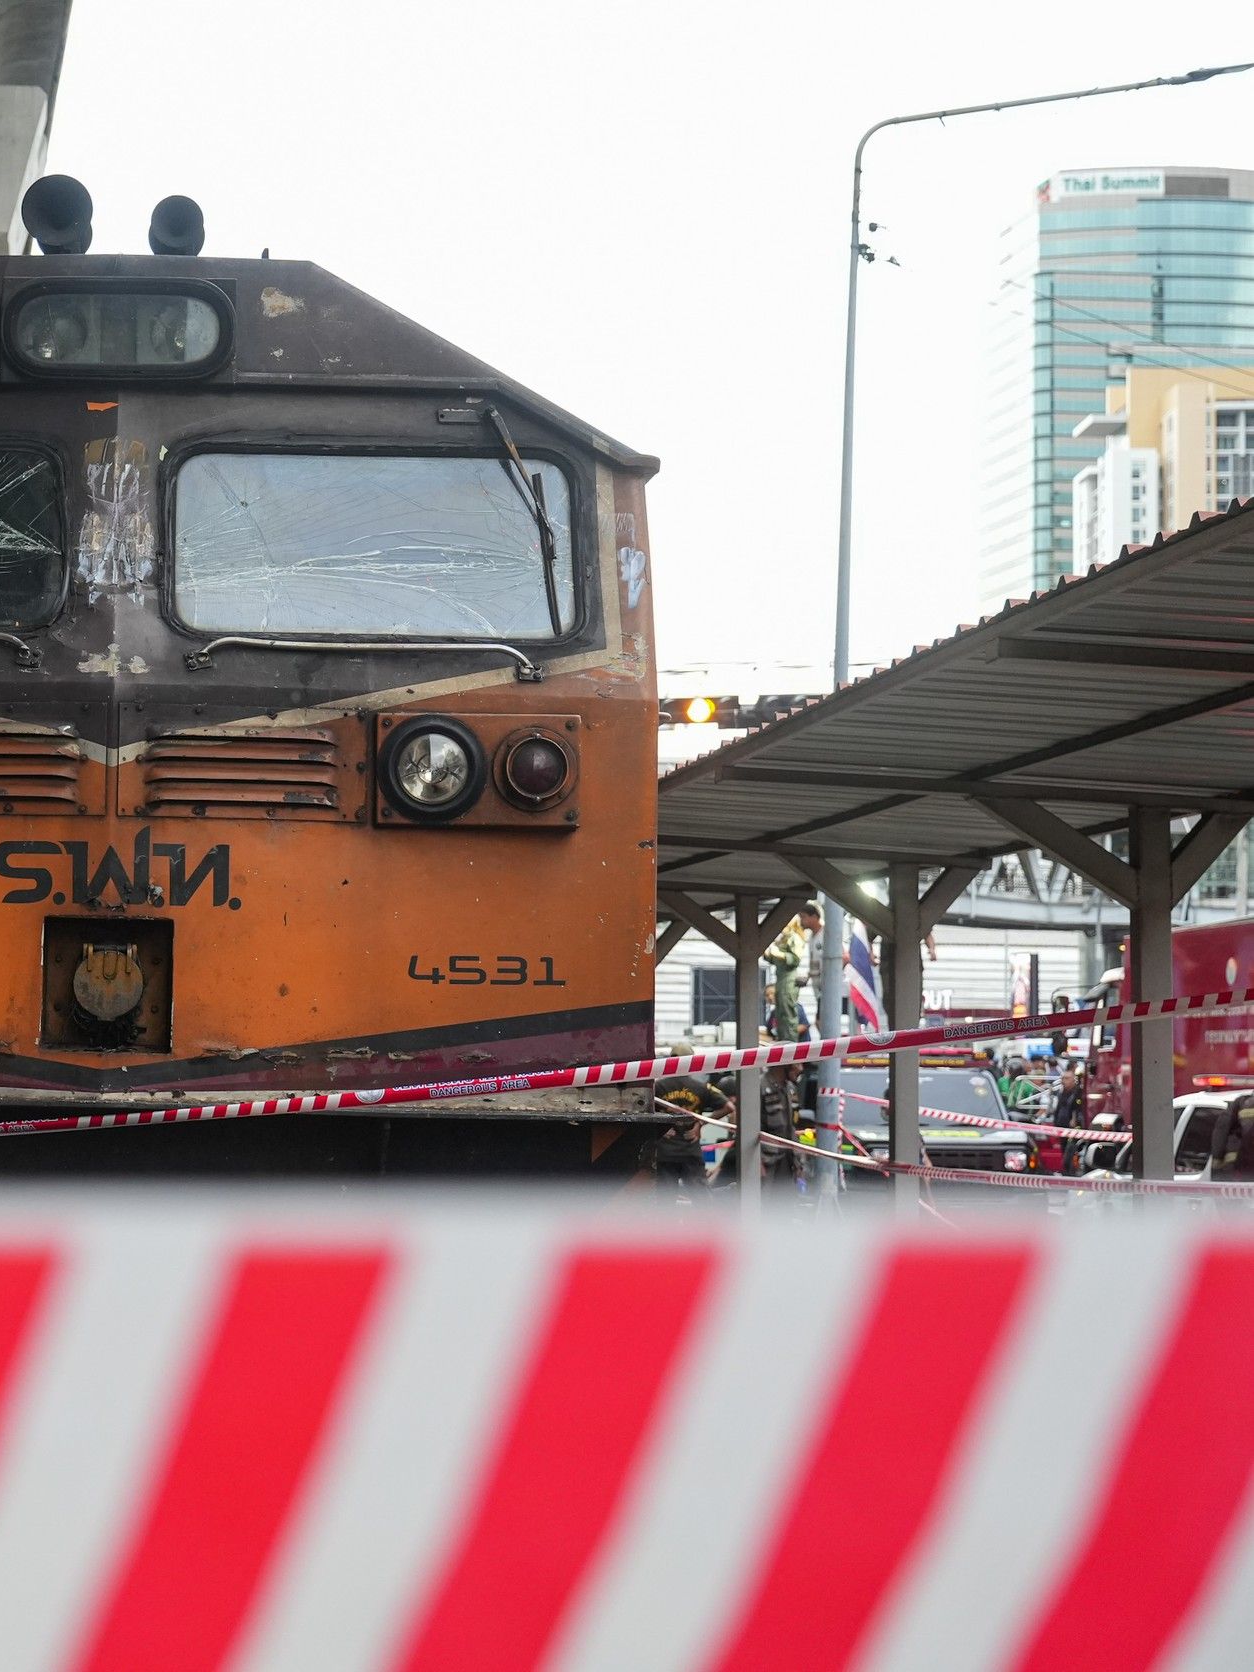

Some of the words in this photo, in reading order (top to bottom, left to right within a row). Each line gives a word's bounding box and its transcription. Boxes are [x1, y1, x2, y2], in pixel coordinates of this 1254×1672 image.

[1064, 176, 1095, 192] Thai
[1102, 173, 1160, 190] Summit
[407, 955, 567, 987] 4531
[944, 1021, 1014, 1038] DANGEROUS
[1018, 1016, 1049, 1028] AREA
[430, 1082, 498, 1098] DANGEROUS
[501, 1078, 531, 1090] AREA
[8, 1124, 36, 1133] AREA
